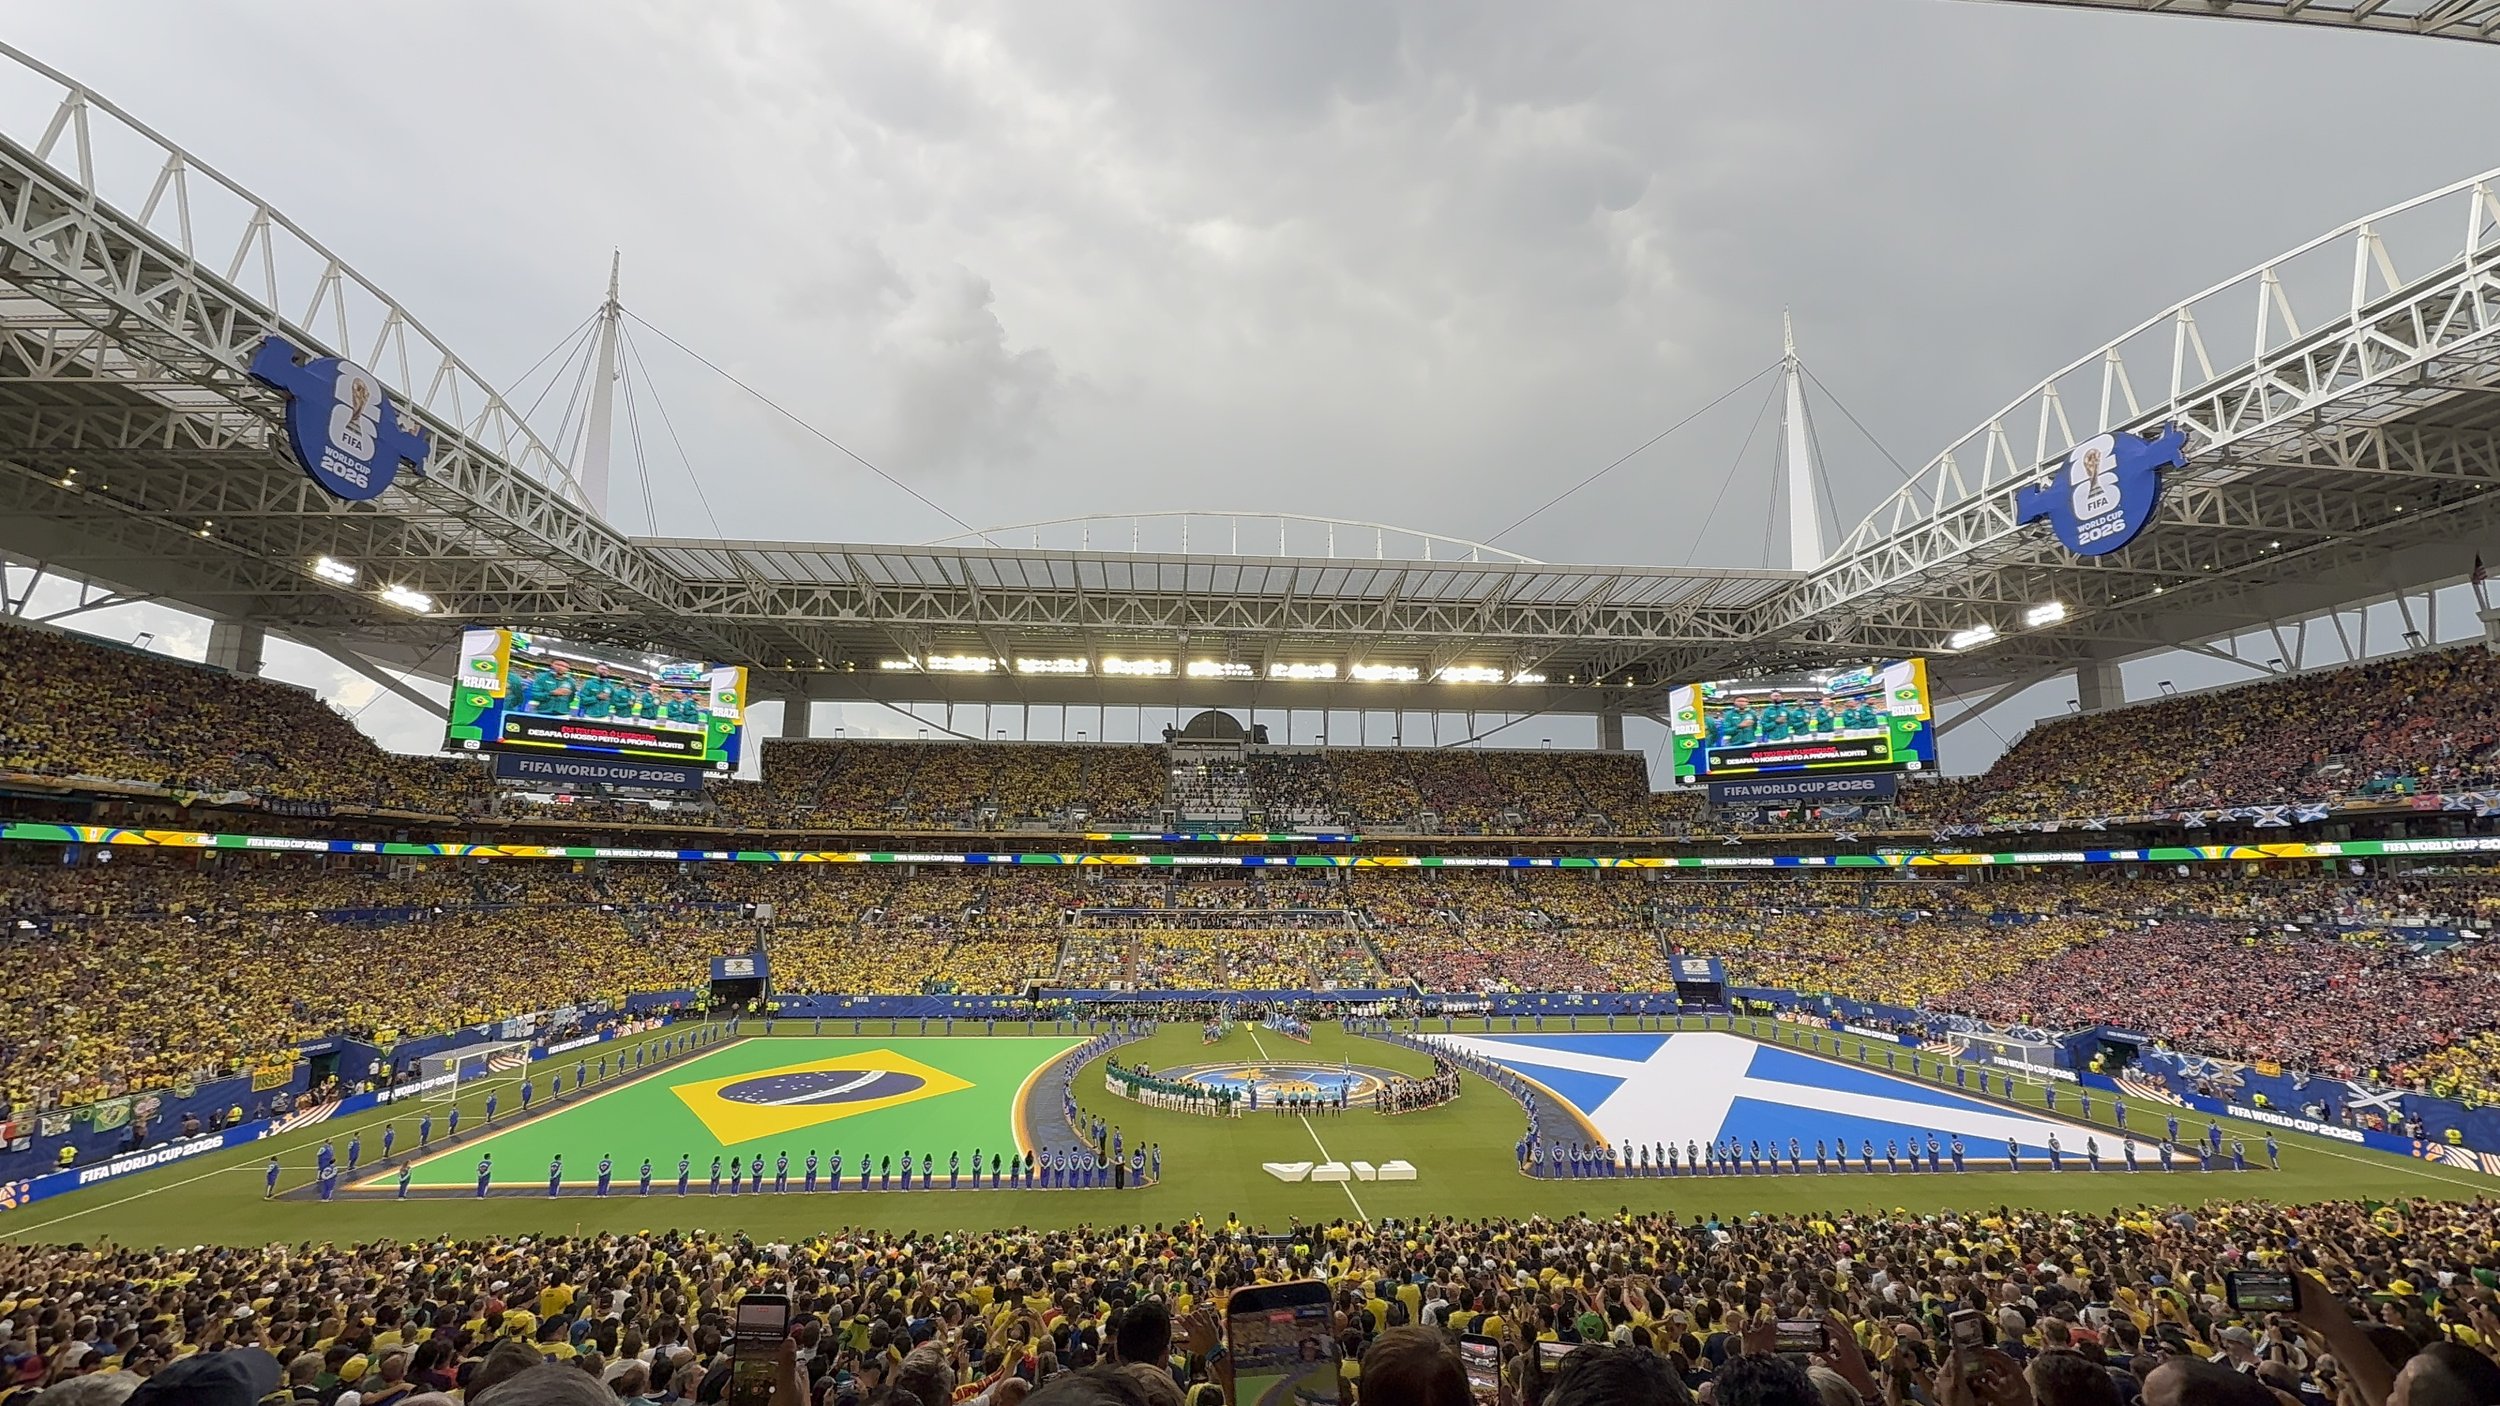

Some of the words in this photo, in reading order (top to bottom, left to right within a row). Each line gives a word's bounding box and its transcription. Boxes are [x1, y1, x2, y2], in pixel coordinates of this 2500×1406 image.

[342, 433, 363, 451] FIFA
[325, 445, 355, 469] WORLD
[355, 458, 371, 475] CUP
[320, 455, 368, 489] 2026
[2087, 497, 2108, 512] FIFA
[2078, 517, 2106, 533] WORLD
[2107, 510, 2124, 523] CUP
[2079, 519, 2126, 546] 2026
[463, 675, 500, 690] BRAZIL
[712, 707, 740, 719] BRAZIL
[1892, 704, 1925, 716] BRAZIL
[528, 729, 562, 738] DESAFIA
[570, 734, 598, 742] NOSSO
[520, 761, 552, 774] FIFA
[555, 764, 608, 777] WORLD
[610, 768, 637, 779] CUP
[639, 770, 685, 782] 2026
[1724, 786, 1750, 796] FIFA
[1751, 783, 1797, 795] WORLD
[1799, 782, 1825, 792] CUP
[1827, 780, 1875, 791] 2026
[247, 838, 262, 846] FIFA
[262, 839, 290, 848] WORLD
[290, 840, 305, 849] CUP
[2383, 843, 2409, 852] FIFA
[2409, 842, 2452, 851] WORLD
[2453, 841, 2478, 850] CUP
[595, 849, 612, 857] FIFA
[639, 850, 654, 858] CUP
[1871, 1030, 1881, 1038] CUP
[575, 1039, 584, 1047] CUP
[1994, 1056, 2008, 1066] FIFA
[2034, 1064, 2048, 1074] CUP
[2049, 1068, 2076, 1081] 2026
[395, 1083, 420, 1097] WORLD
[421, 1079, 435, 1090] CUP
[2227, 1105, 2253, 1120] FIFA
[2253, 1109, 2294, 1128] WORLD
[2294, 1119, 2319, 1133] CUP
[2319, 1124, 2365, 1143] 2026
[80, 1166, 110, 1184] FIFA
[110, 1153, 157, 1175] WORLD
[157, 1147, 183, 1162] CUP
[182, 1136, 223, 1156] 2026
